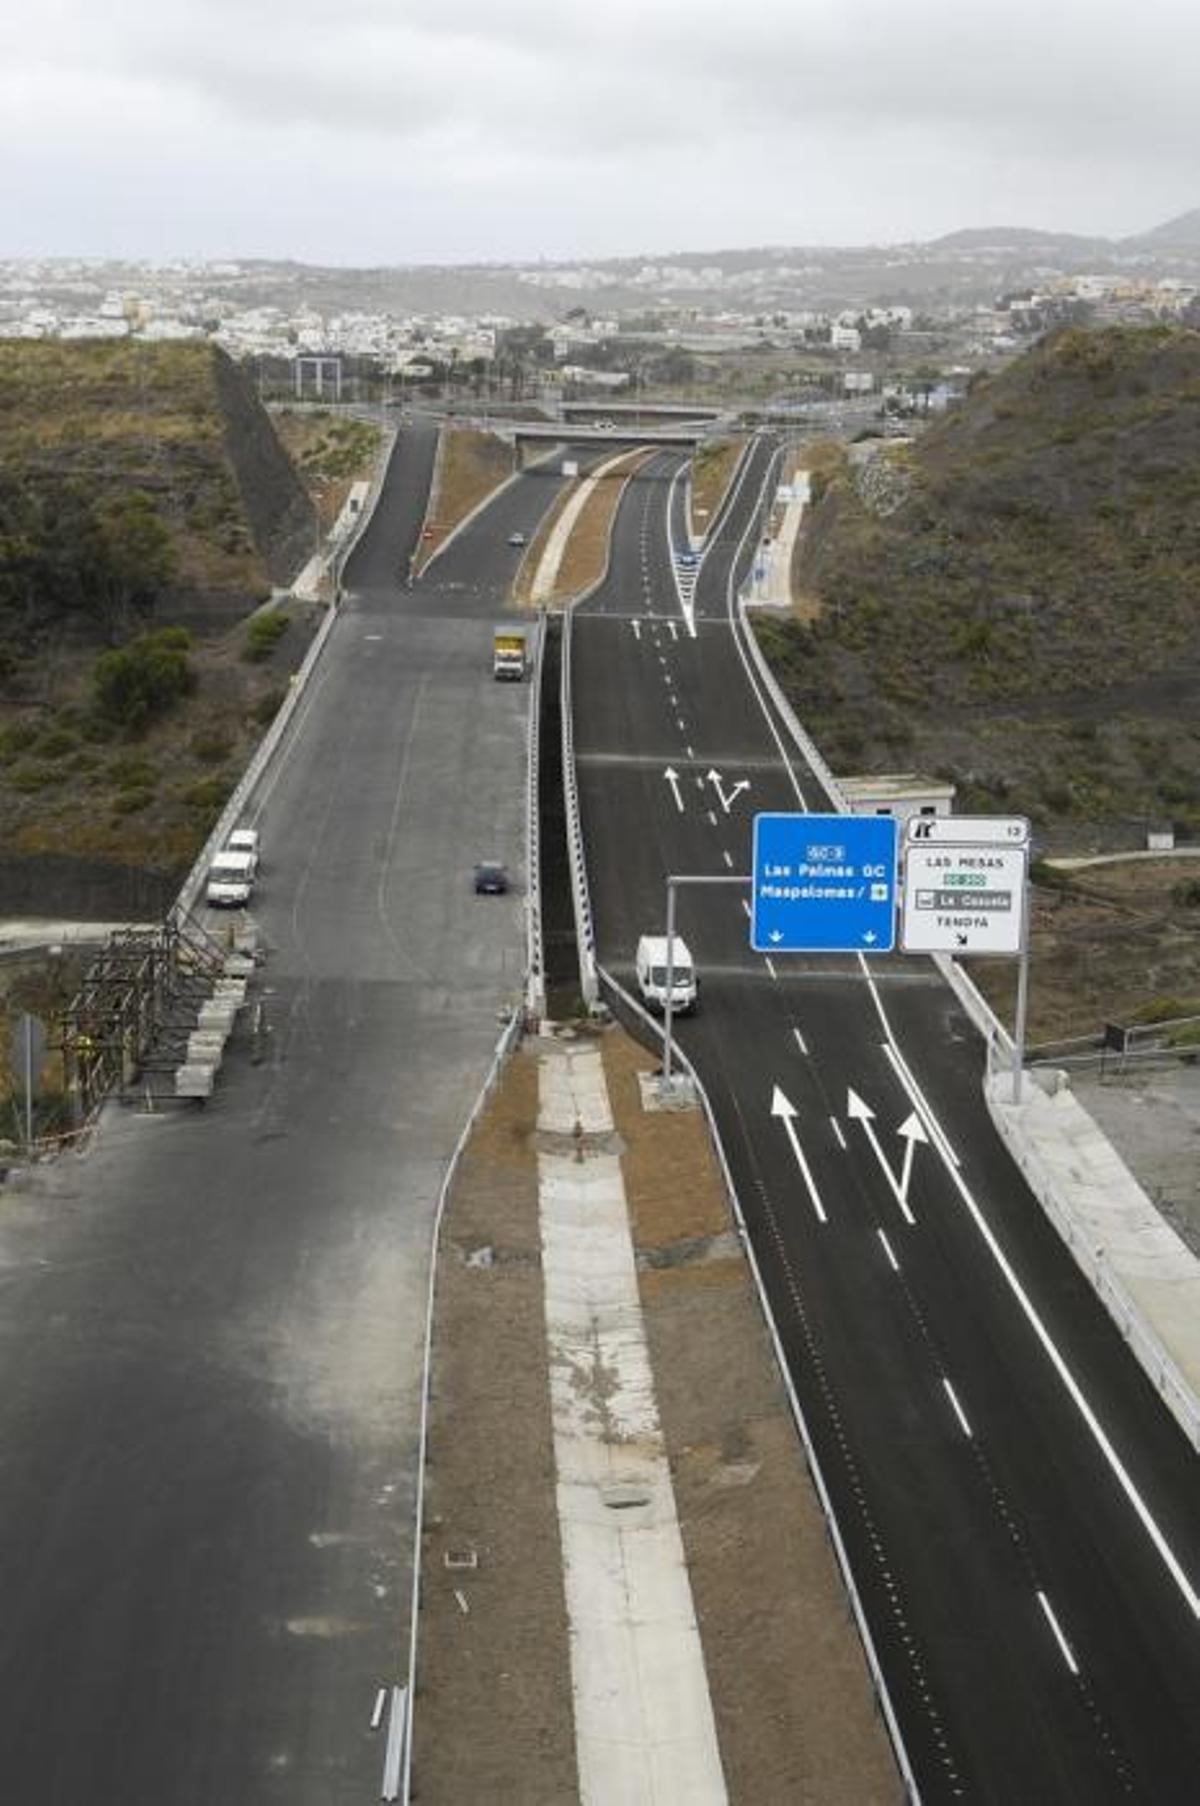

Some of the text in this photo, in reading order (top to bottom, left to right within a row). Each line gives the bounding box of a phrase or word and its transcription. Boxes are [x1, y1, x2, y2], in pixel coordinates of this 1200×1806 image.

[926, 857, 1004, 868] LAS MESAS
[764, 863, 885, 877] Las Palmas GC
[937, 916, 988, 928] TENOYA
